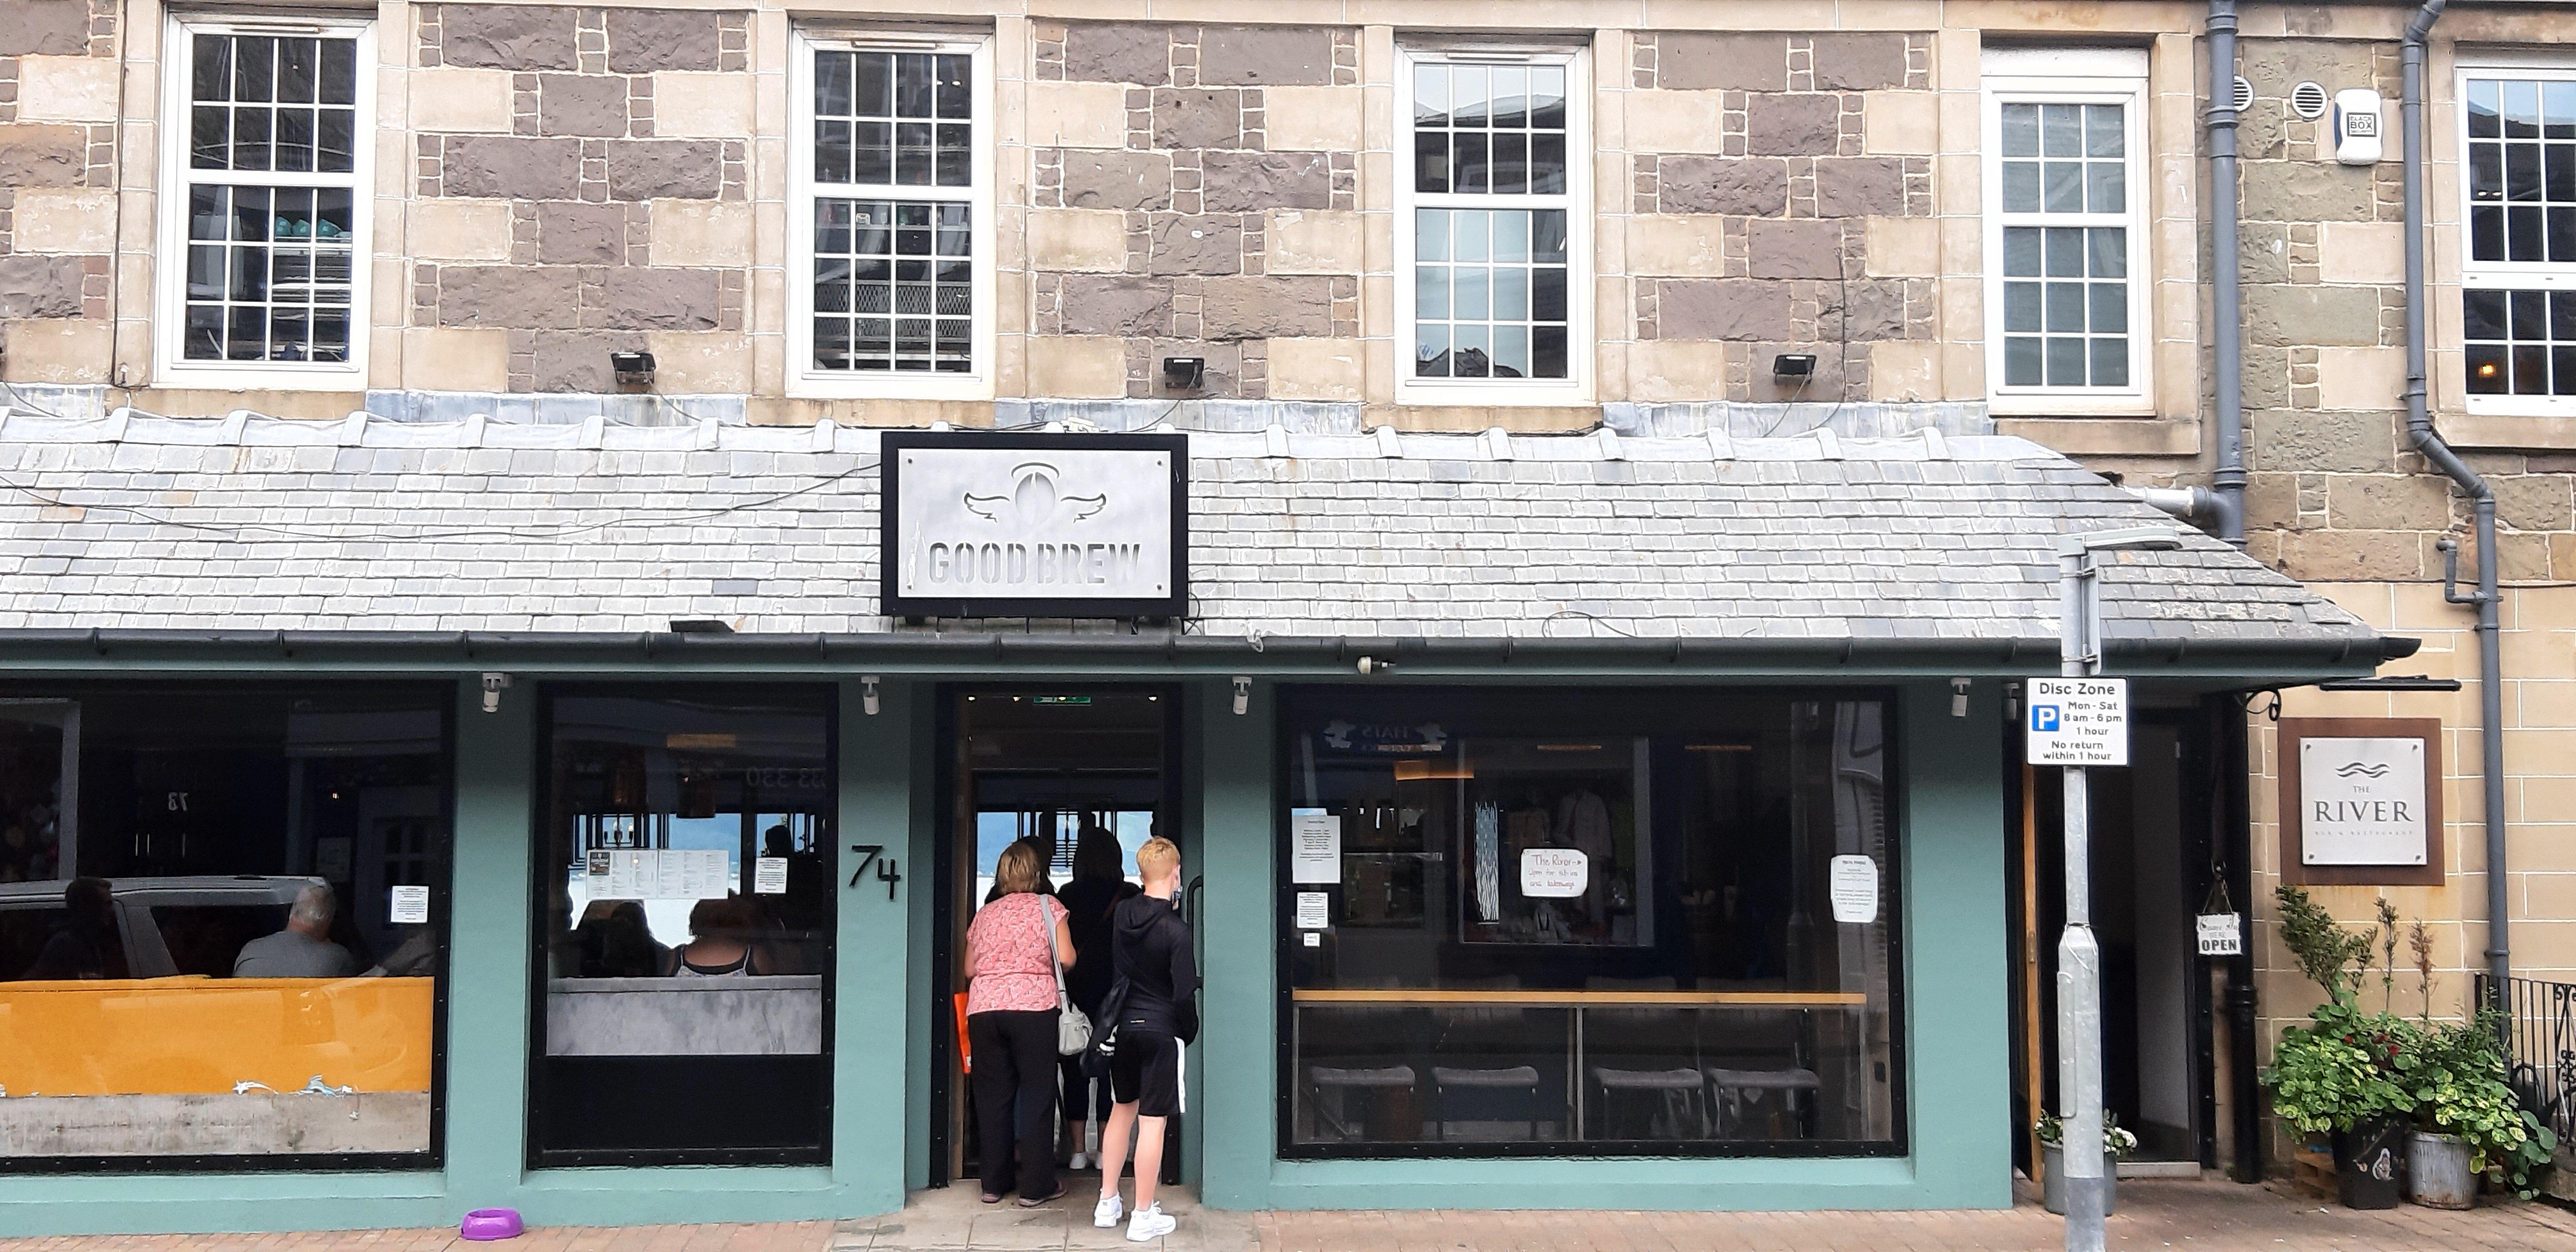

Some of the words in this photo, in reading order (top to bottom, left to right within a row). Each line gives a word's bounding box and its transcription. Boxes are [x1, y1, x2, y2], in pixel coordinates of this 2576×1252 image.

[2350, 120, 2372, 130] BOX
[929, 542, 1026, 584] GOOD
[1037, 544, 1141, 584] BREW
[2040, 682, 2072, 695] Disc
[2078, 683, 2115, 695] Zone
[2068, 702, 2090, 710] Mon
[2099, 702, 2118, 710] Sat
[2038, 707, 2056, 729] P
[2077, 727, 2080, 735] 1
[2085, 727, 2109, 735] hour
[2052, 741, 2066, 749] No
[2043, 752, 2075, 760] within
[2080, 752, 2083, 760] 1
[2088, 752, 2112, 760] hour
[2353, 785, 2370, 793] THE
[2314, 801, 2414, 822] RIVER
[1531, 854, 1550, 866] The
[849, 845, 901, 900] 74
[2202, 939, 2237, 951] OPEN
